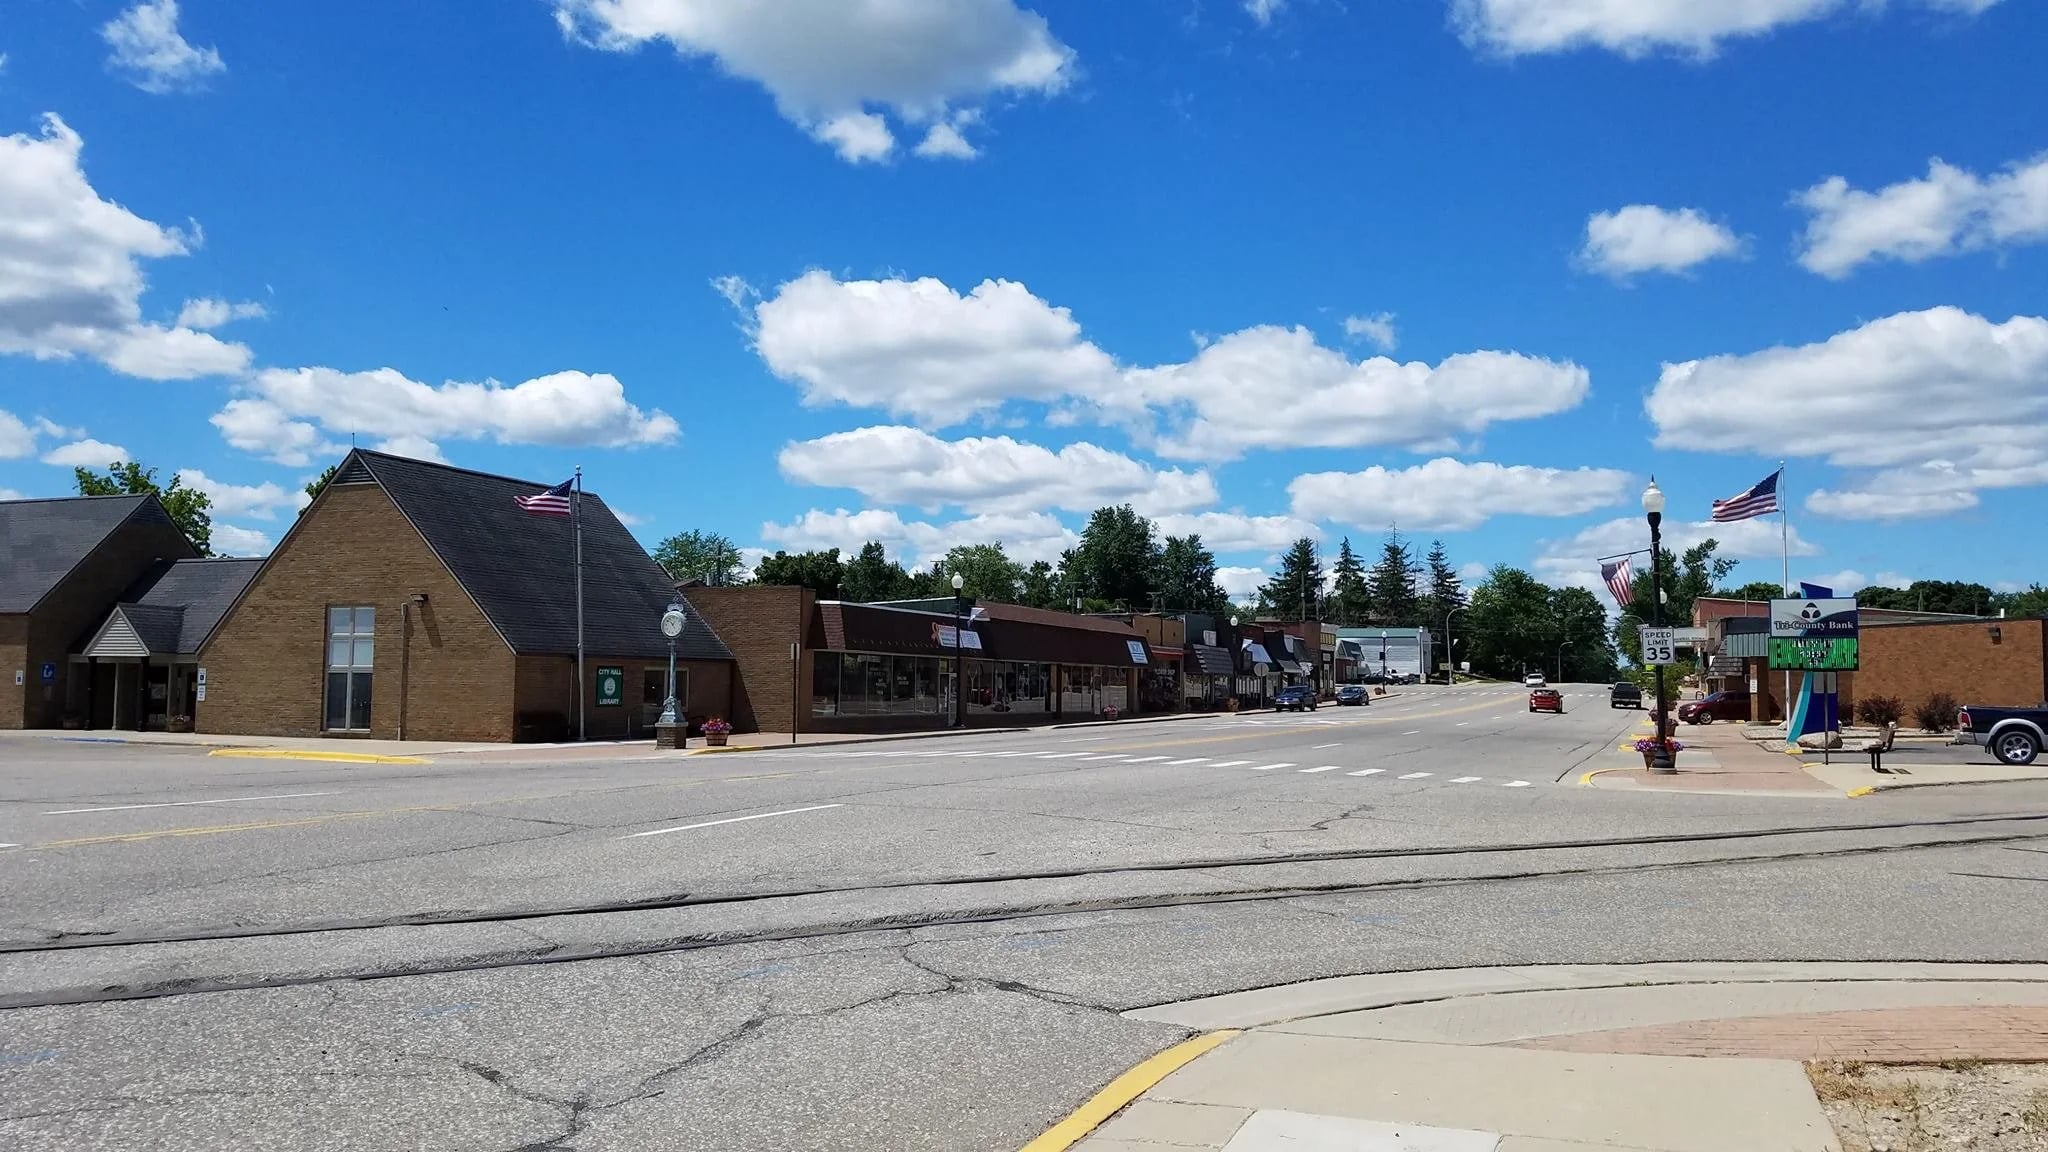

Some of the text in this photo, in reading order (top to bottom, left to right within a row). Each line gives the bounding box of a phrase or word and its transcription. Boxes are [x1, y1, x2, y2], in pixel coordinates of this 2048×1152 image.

[1774, 620, 1854, 631] Tri-County Bank
[1644, 631, 1672, 639] SPEED
[1646, 647, 1671, 661] 35
[598, 668, 622, 676] CITY HALL
